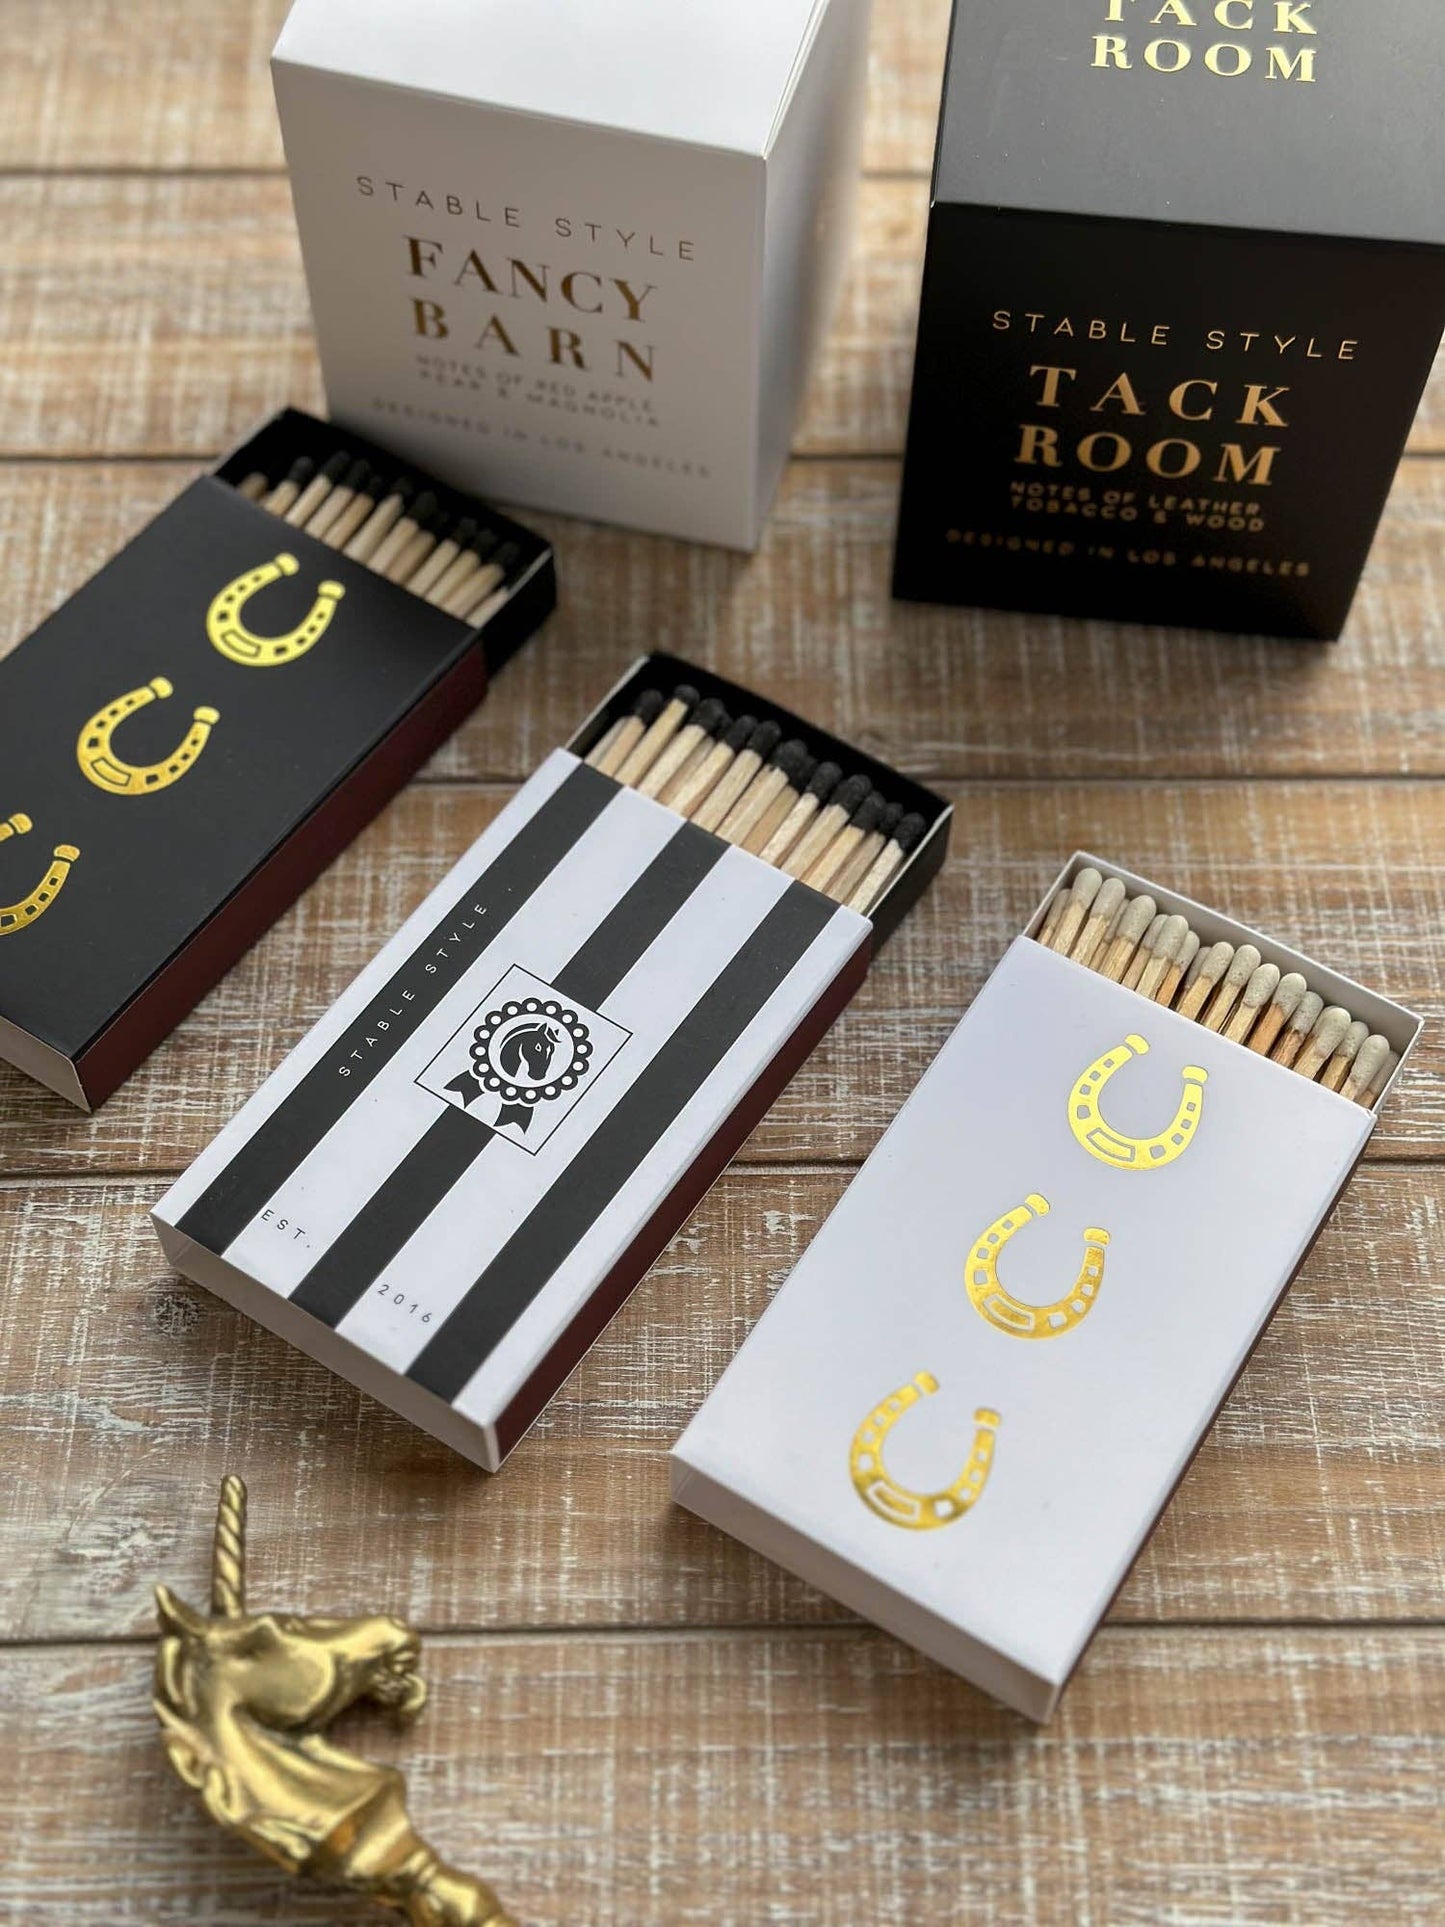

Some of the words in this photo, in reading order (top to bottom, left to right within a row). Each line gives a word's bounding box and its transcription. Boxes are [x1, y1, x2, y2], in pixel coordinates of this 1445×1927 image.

[1091, 35, 1316, 82] ROOM
[356, 176, 520, 228] STABLE
[555, 217, 695, 261] STYLE
[403, 234, 658, 323] FANCY
[410, 297, 657, 383] BARN
[992, 310, 1170, 346] STABLE
[1206, 330, 1360, 360] STYLE
[415, 354, 487, 380] NOTES
[1029, 364, 1290, 427] TACK
[1013, 423, 1281, 486] ROOM
[1010, 481, 1091, 502] NOTES
[1103, 490, 1136, 504] OF
[1149, 495, 1260, 515] LEATHER
[1011, 495, 1138, 521] TOBACCO
[1186, 514, 1264, 532] WOOD
[946, 528, 1074, 556] DESIGNED
[1127, 550, 1176, 566] LOS
[1192, 555, 1309, 576] ANGELES
[339, 990, 415, 1076] STABLE
[425, 904, 487, 974] STYLE
[261, 1209, 310, 1248] EST.
[378, 1284, 432, 1323] 2016
